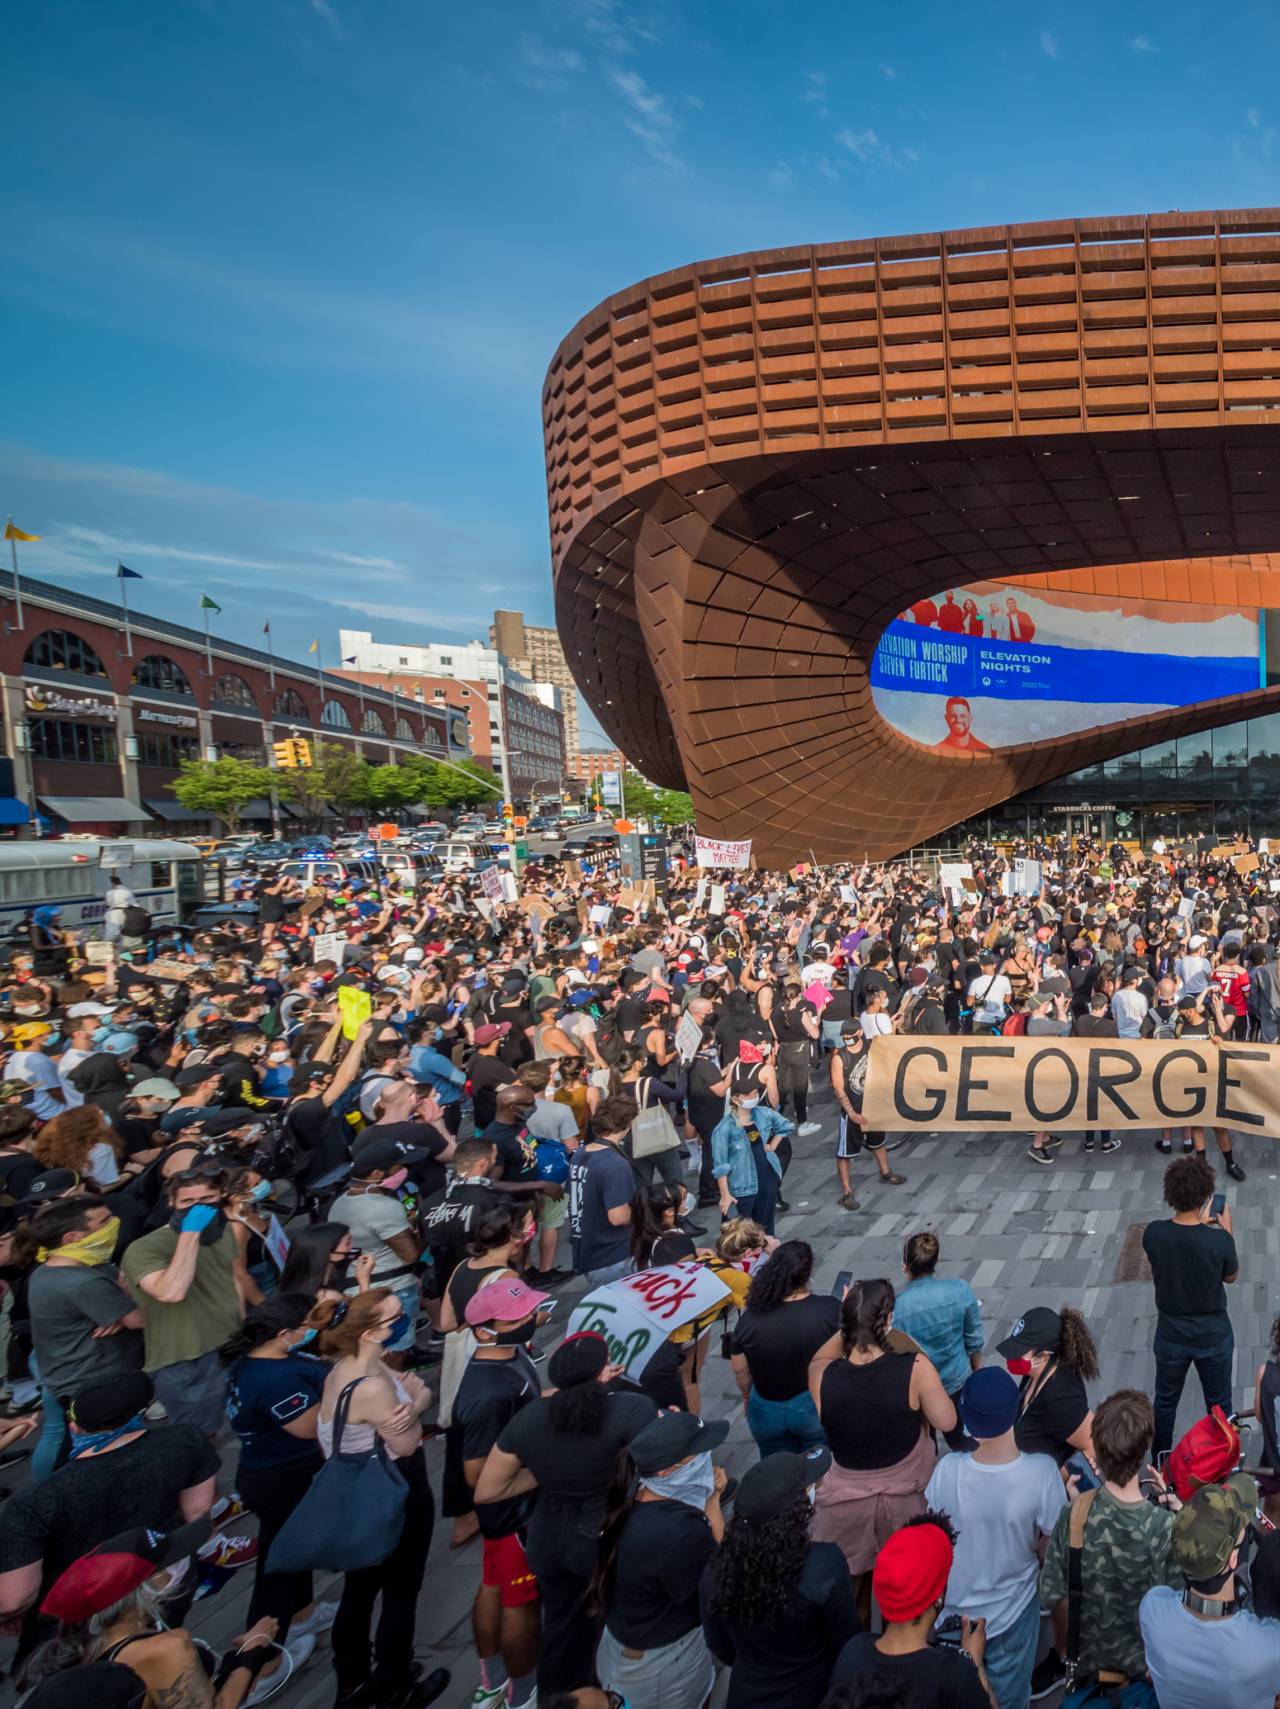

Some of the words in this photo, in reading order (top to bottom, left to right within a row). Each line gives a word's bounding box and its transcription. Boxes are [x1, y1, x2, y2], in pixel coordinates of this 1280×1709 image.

[921, 641, 968, 666] WORSHIP
[980, 650, 1052, 665] ELEVATION
[879, 653, 906, 678] STEVEN
[909, 662, 949, 683] FURTICK
[980, 661, 1032, 674] NIGHTS
[697, 839, 721, 850] BLACK
[725, 843, 751, 854] LIVES
[713, 852, 740, 865] MATTER
[1221, 978, 1232, 997] 7
[893, 1045, 1275, 1128] GEORGE
